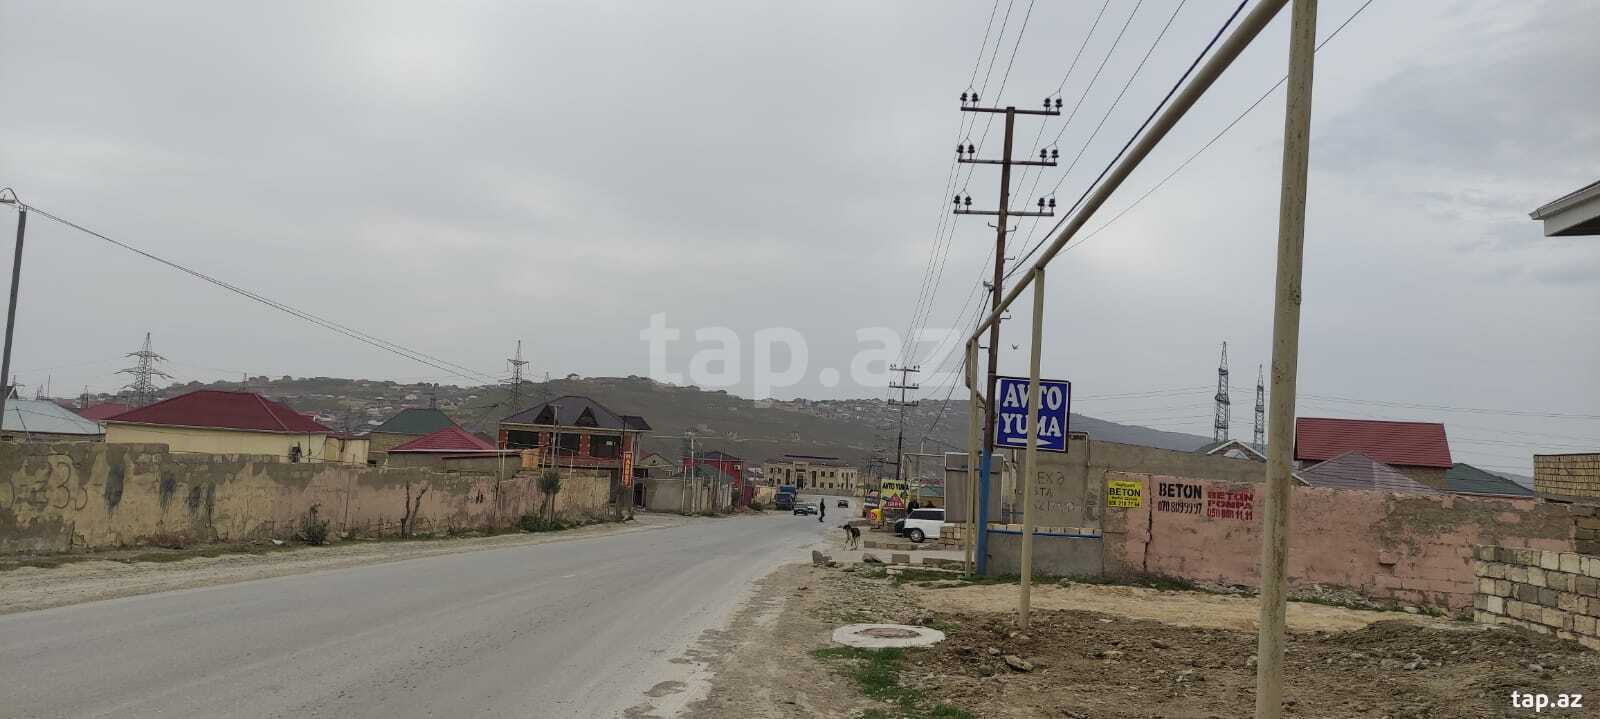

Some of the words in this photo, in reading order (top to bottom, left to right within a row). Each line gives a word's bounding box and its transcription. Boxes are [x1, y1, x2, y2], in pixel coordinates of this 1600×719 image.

[1109, 487, 1141, 497] BETON
[1159, 482, 1202, 500] BETON
[1207, 490, 1254, 502] BETON
